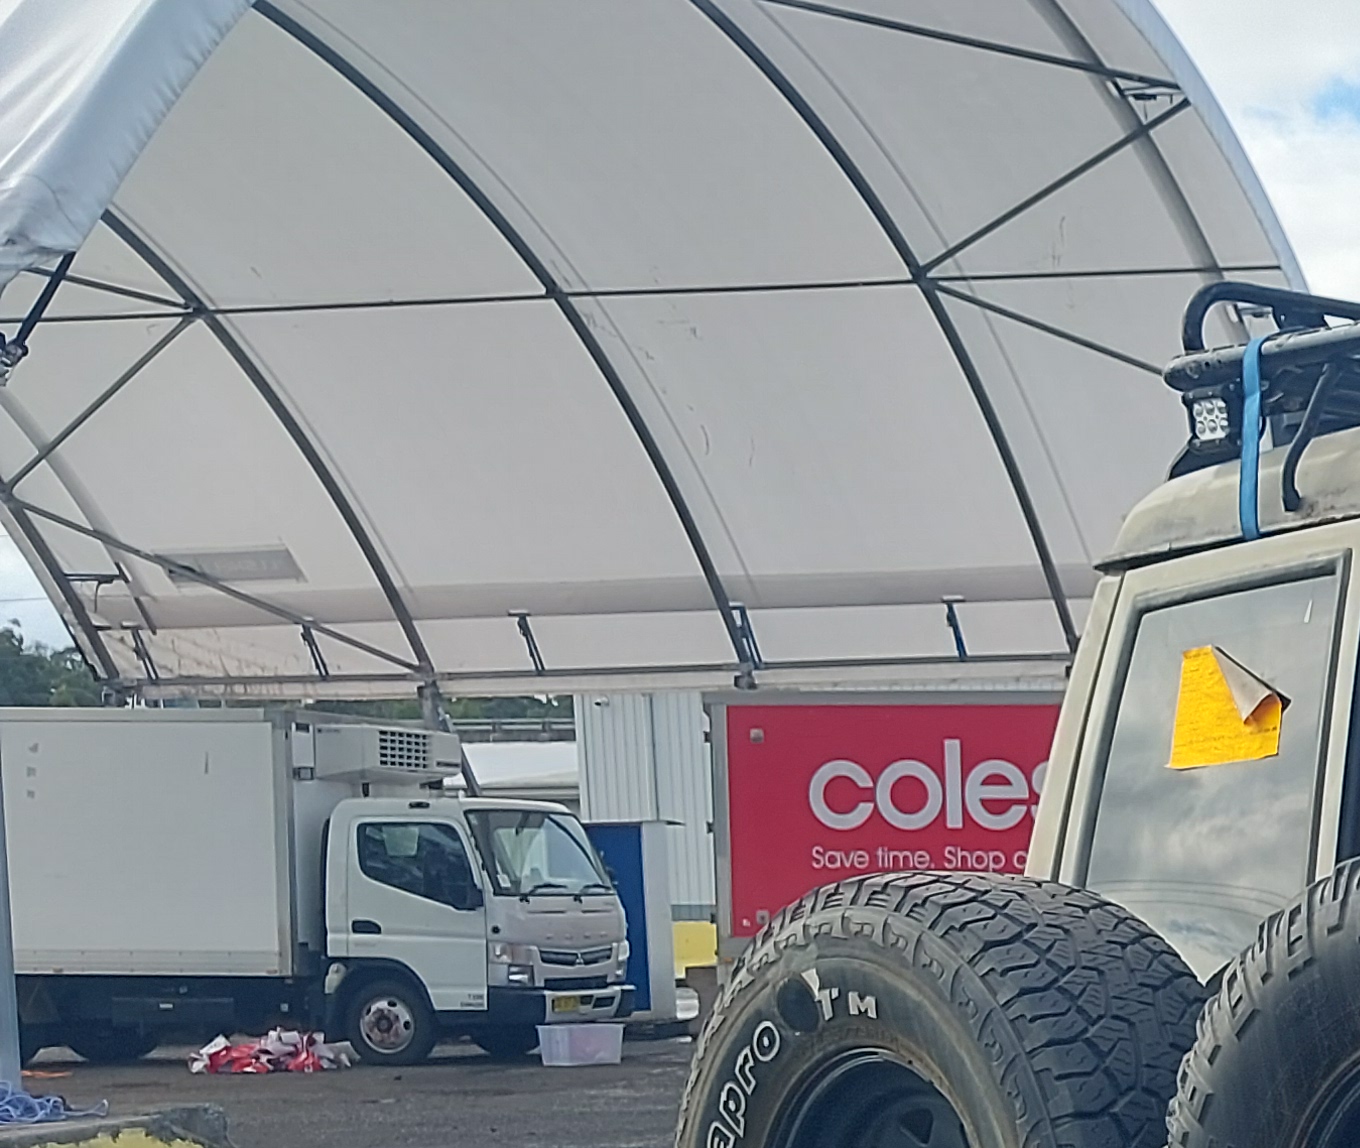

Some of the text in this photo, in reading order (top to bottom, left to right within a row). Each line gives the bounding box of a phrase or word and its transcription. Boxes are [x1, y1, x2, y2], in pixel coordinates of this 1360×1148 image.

[811, 846, 869, 869] Save
[876, 846, 935, 869] time.
[944, 846, 1005, 872] Shop
